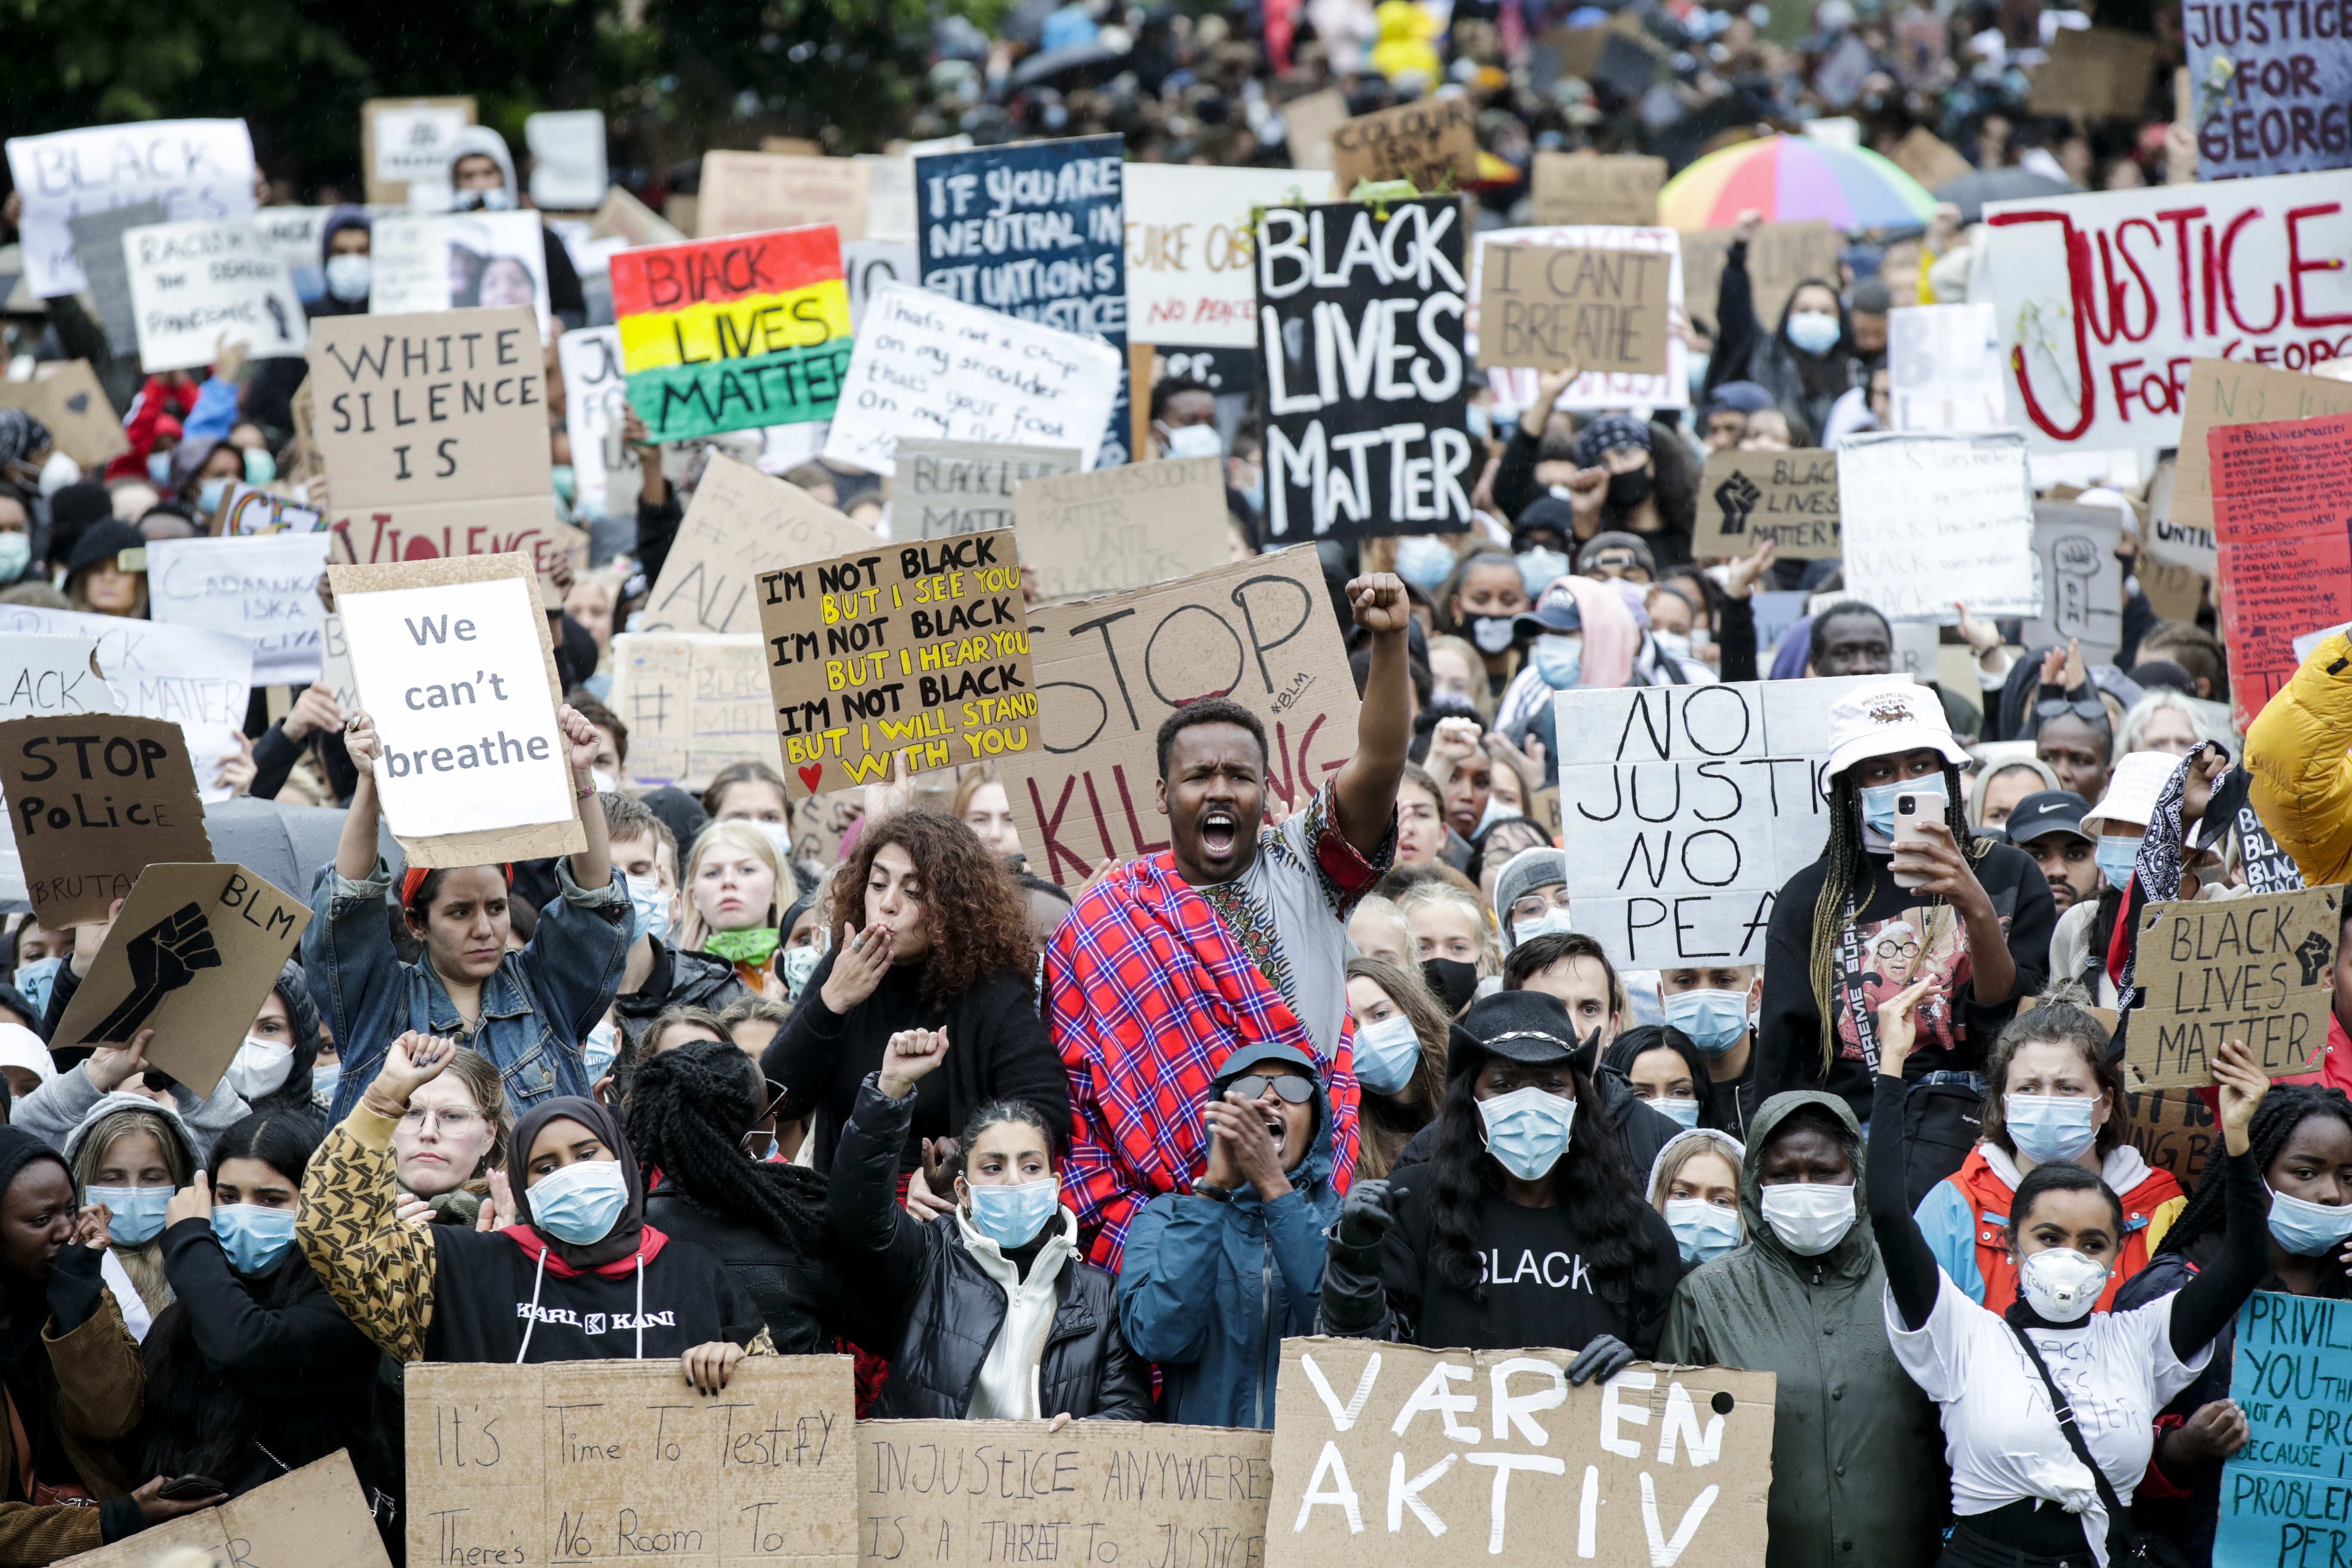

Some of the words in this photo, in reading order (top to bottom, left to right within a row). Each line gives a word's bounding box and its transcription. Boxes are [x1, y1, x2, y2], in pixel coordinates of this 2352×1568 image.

[2234, 55, 2321, 101] FOR
[32, 136, 224, 198] BLACK
[928, 173, 978, 219] IF
[1055, 156, 1122, 203] ARE
[929, 211, 1084, 259] NEUTRAL
[1088, 205, 1122, 245] IN
[1257, 204, 1465, 298] BLACK
[925, 253, 1116, 307] SITUATIONS
[1490, 246, 1524, 294] I
[674, 297, 830, 365] LIVES
[1147, 297, 1186, 325] NO
[1501, 300, 1648, 363] BREATHE
[1988, 202, 2352, 441] JUSTICE
[326, 329, 521, 382] WHITE
[916, 345, 950, 376] my
[958, 355, 1069, 399] shoulder
[1262, 291, 1465, 415] LIVES
[332, 375, 539, 432] SILENCE
[2215, 373, 2266, 420] NO
[394, 438, 459, 479] IS
[914, 454, 993, 495] BLACK
[1038, 478, 1083, 505] ALL
[1086, 465, 1152, 499] LIVES
[1267, 420, 1472, 536] MATTER
[1773, 459, 1838, 486] BLAC
[1037, 498, 1131, 532] MATTER
[1082, 523, 1161, 560] UNTIL
[762, 570, 805, 605] I'M
[818, 557, 882, 594] NOT
[900, 536, 997, 579] BLACK
[1850, 548, 1931, 577] BLACK
[242, 599, 308, 622] ISKA
[821, 586, 881, 625] BUT
[891, 583, 903, 609] I
[914, 571, 966, 604] SEE
[972, 566, 1021, 594] YOU
[404, 613, 477, 646] We
[771, 630, 819, 666] I'M
[827, 616, 889, 655] NOT
[911, 596, 1016, 639] BLACK
[825, 649, 891, 691] BUT
[899, 647, 913, 676] I
[919, 635, 990, 671] HEAR
[989, 629, 1030, 659] YOU
[1028, 574, 1313, 754] STOP
[140, 676, 243, 726] MATTER
[404, 670, 508, 711] can't
[779, 697, 830, 736] I'M
[842, 683, 905, 723] NOT
[919, 662, 1025, 707] BLACK
[1270, 672, 1309, 714] #BLM
[1862, 697, 1875, 707] POLO
[1875, 692, 1893, 701] RALPH
[1894, 692, 1914, 701] LAUREN
[786, 726, 849, 764] BUT
[861, 723, 871, 750] I
[878, 707, 956, 742] WILL
[961, 691, 1039, 727] STAND
[1616, 685, 1749, 761] NO
[21, 734, 167, 783] STOP
[383, 730, 550, 778] breathe
[841, 738, 950, 785] WITH
[963, 726, 1028, 759] YOU
[1026, 714, 1352, 885] KILNG
[1617, 829, 1741, 890] NO
[30, 873, 138, 906] BRUTA
[220, 874, 296, 940] BLM
[2171, 904, 2295, 963] BLACK
[2176, 962, 2288, 1015] LIVES
[2155, 1012, 2309, 1077] MATTER
[1479, 1248, 1594, 1295] BLACK
[516, 1303, 583, 1329] KARL
[612, 1311, 676, 1330] KANI
[2244, 1348, 2319, 1400] YOU
[437, 1403, 501, 1468] It's
[545, 1403, 622, 1465] Time
[646, 1405, 695, 1461] To
[1301, 1351, 1568, 1447] VÆR
[1600, 1370, 1724, 1467] EN
[2241, 1400, 2274, 1423] NOT
[2274, 1404, 2292, 1429] A
[1103, 1450, 1268, 1502] ANYWERE
[1293, 1439, 1720, 1568] AKTIV
[429, 1508, 525, 1566] There's
[551, 1510, 592, 1564] No
[618, 1508, 704, 1556] Room
[739, 1501, 784, 1553] To
[867, 1515, 909, 1561] IS
[936, 1518, 951, 1562] A
[1148, 1524, 1264, 1568] JUSTICE
